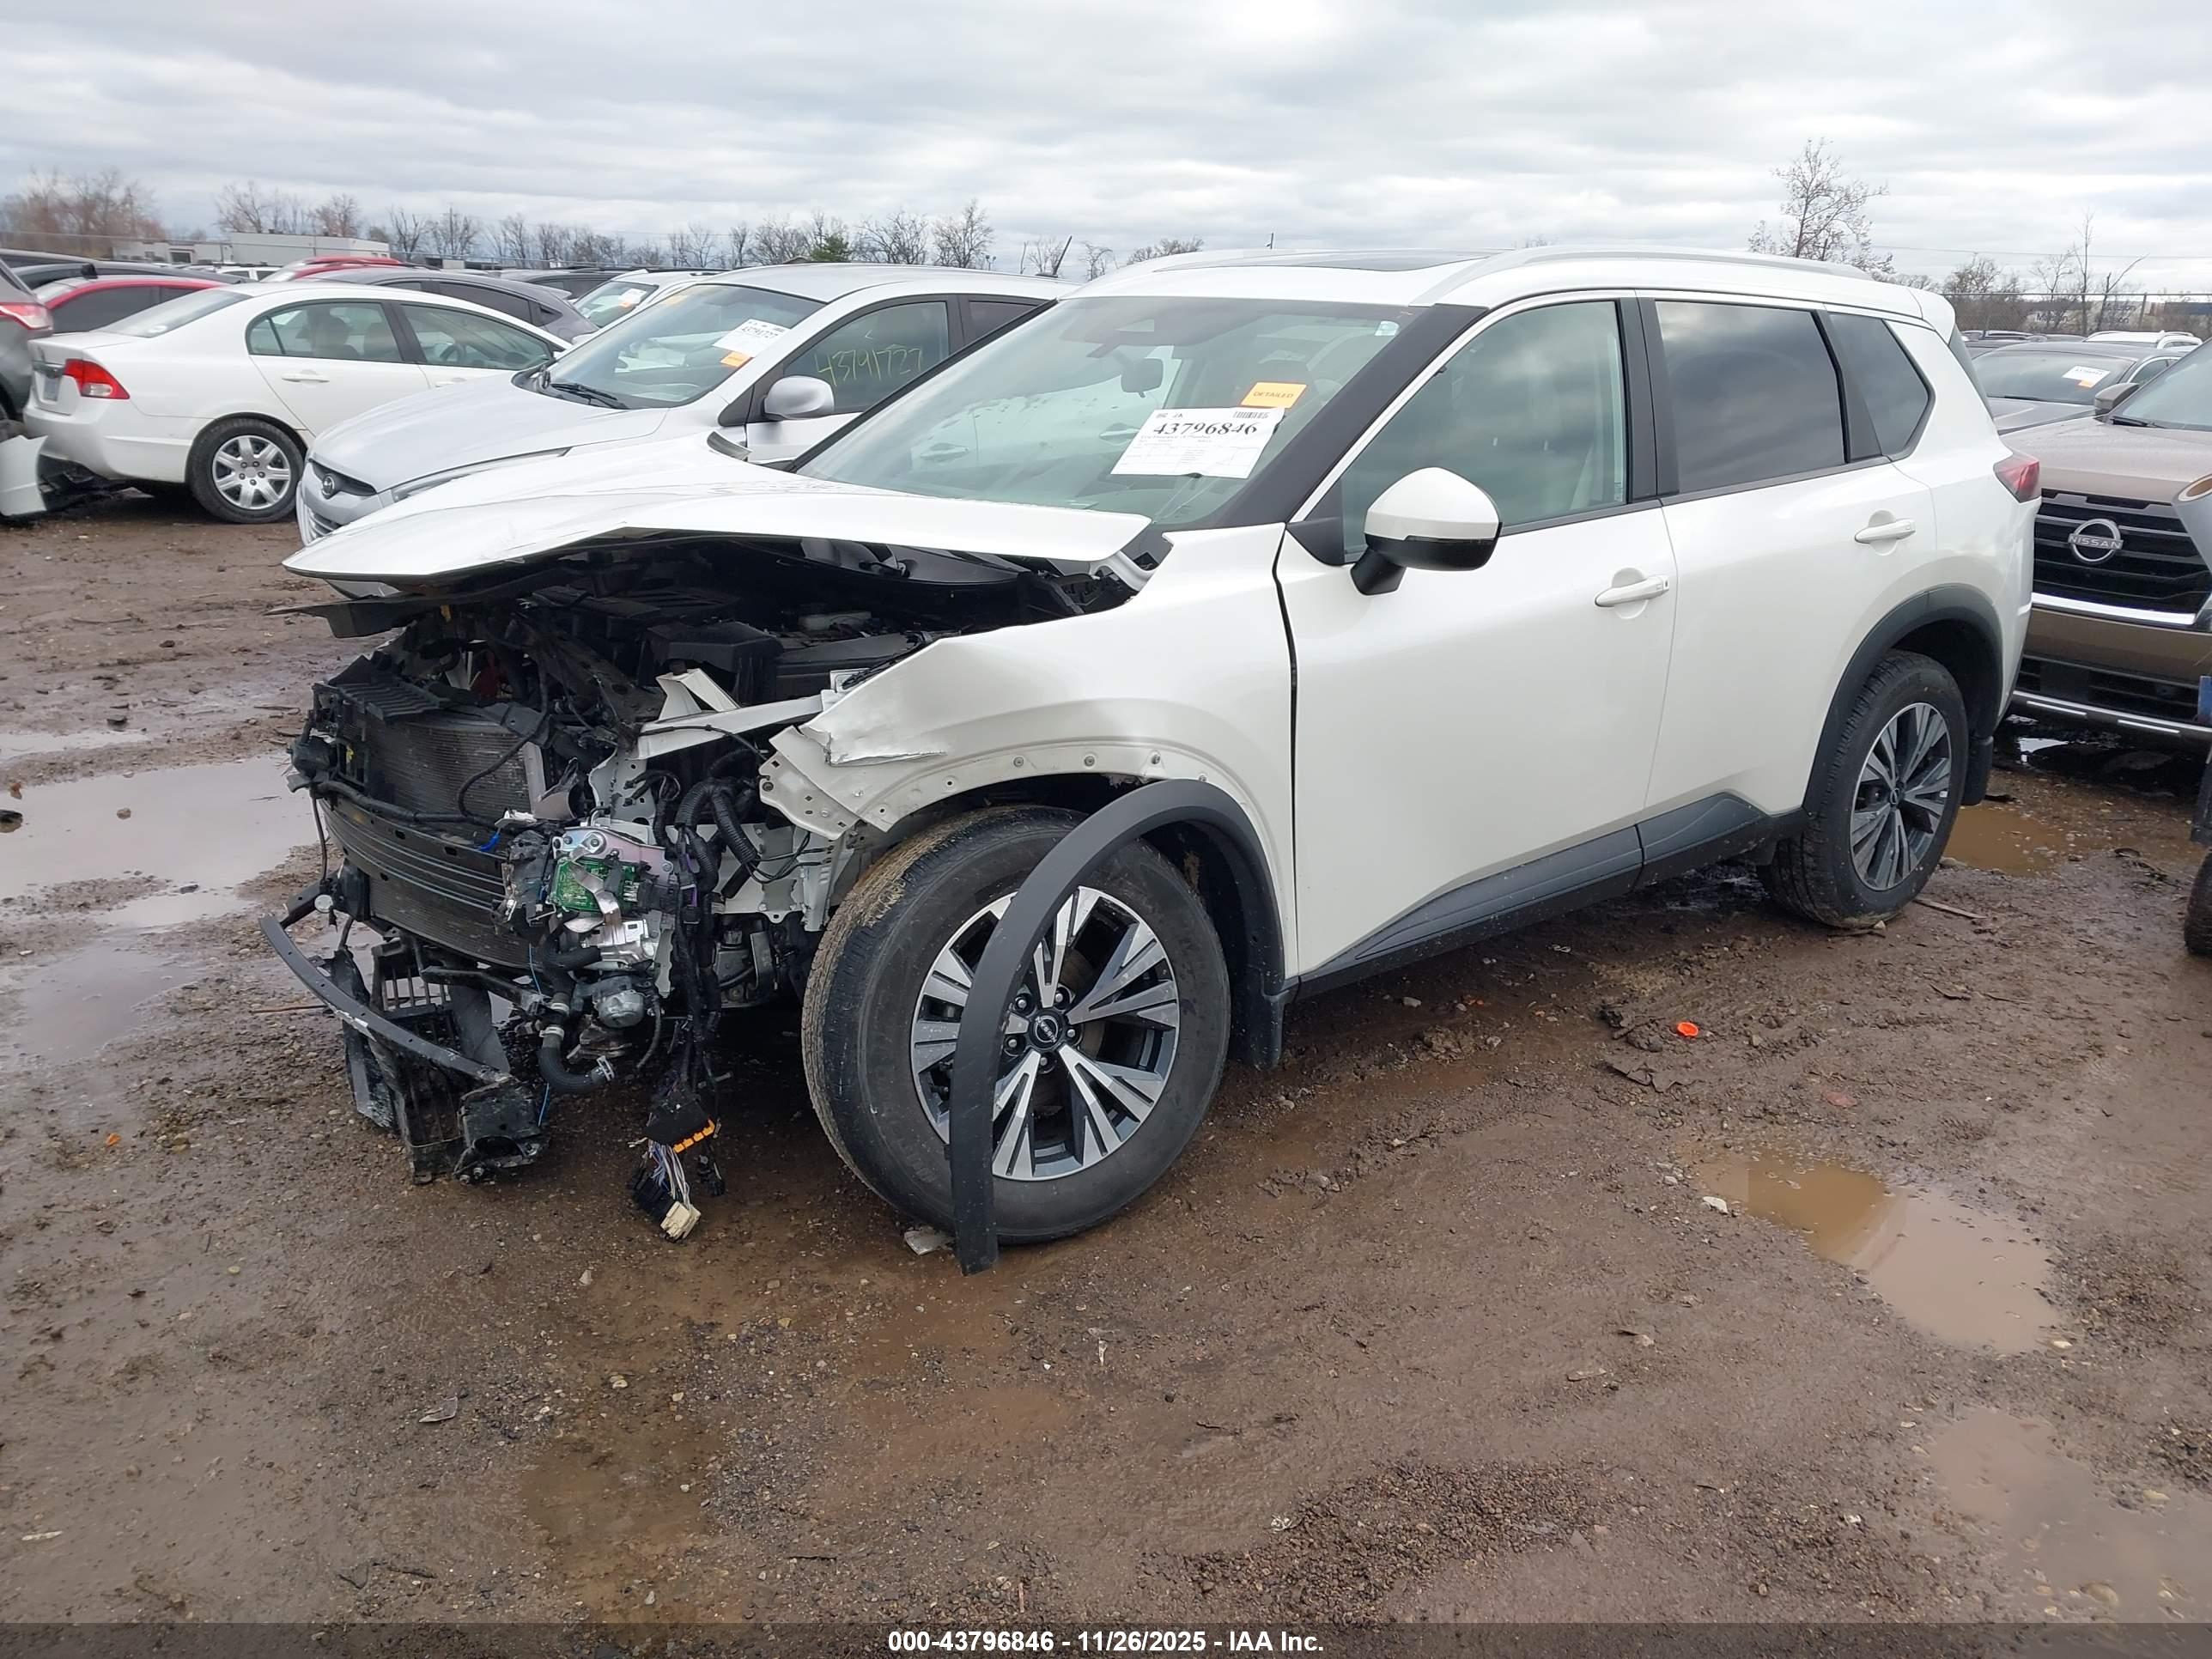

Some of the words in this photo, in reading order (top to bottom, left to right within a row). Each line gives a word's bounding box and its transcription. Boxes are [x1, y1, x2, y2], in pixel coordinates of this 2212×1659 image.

[814, 347, 921, 386] 43791727
[1153, 422, 1258, 435] 43796846
[2069, 534, 2122, 550] NISSAN
